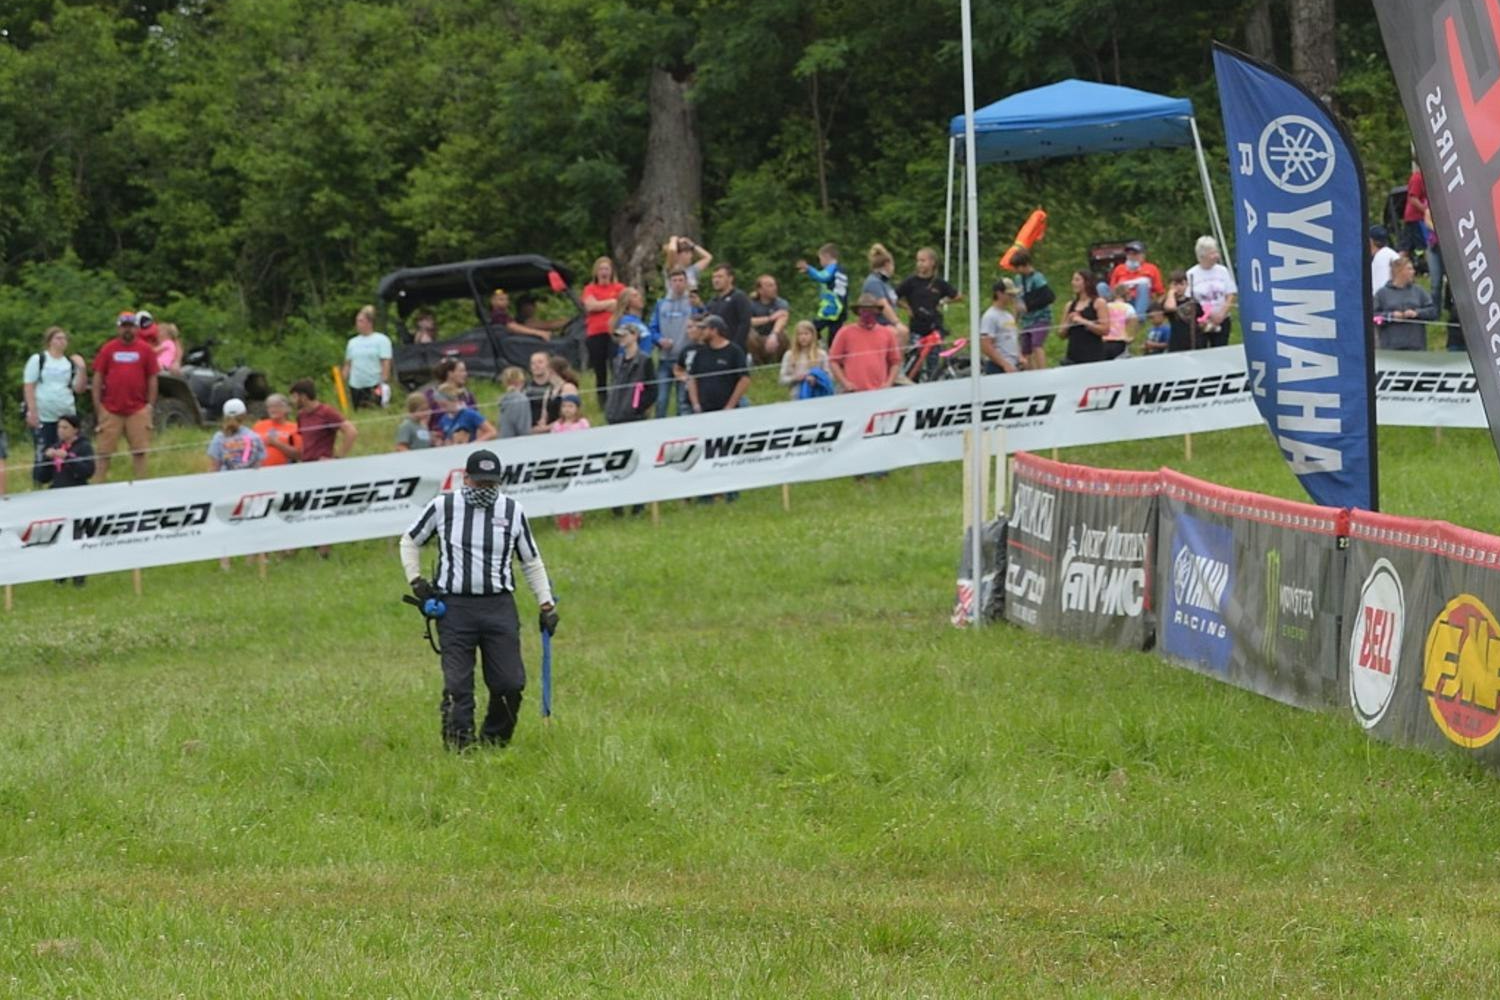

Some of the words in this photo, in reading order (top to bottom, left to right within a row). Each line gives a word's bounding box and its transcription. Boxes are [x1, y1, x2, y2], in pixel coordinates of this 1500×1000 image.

[1238, 142, 1271, 420] RACIN
[1266, 200, 1343, 475] YAMAHA
[1377, 371, 1480, 393] iSECO
[1174, 610, 1227, 639] RACING
[1359, 606, 1395, 675] BELL
